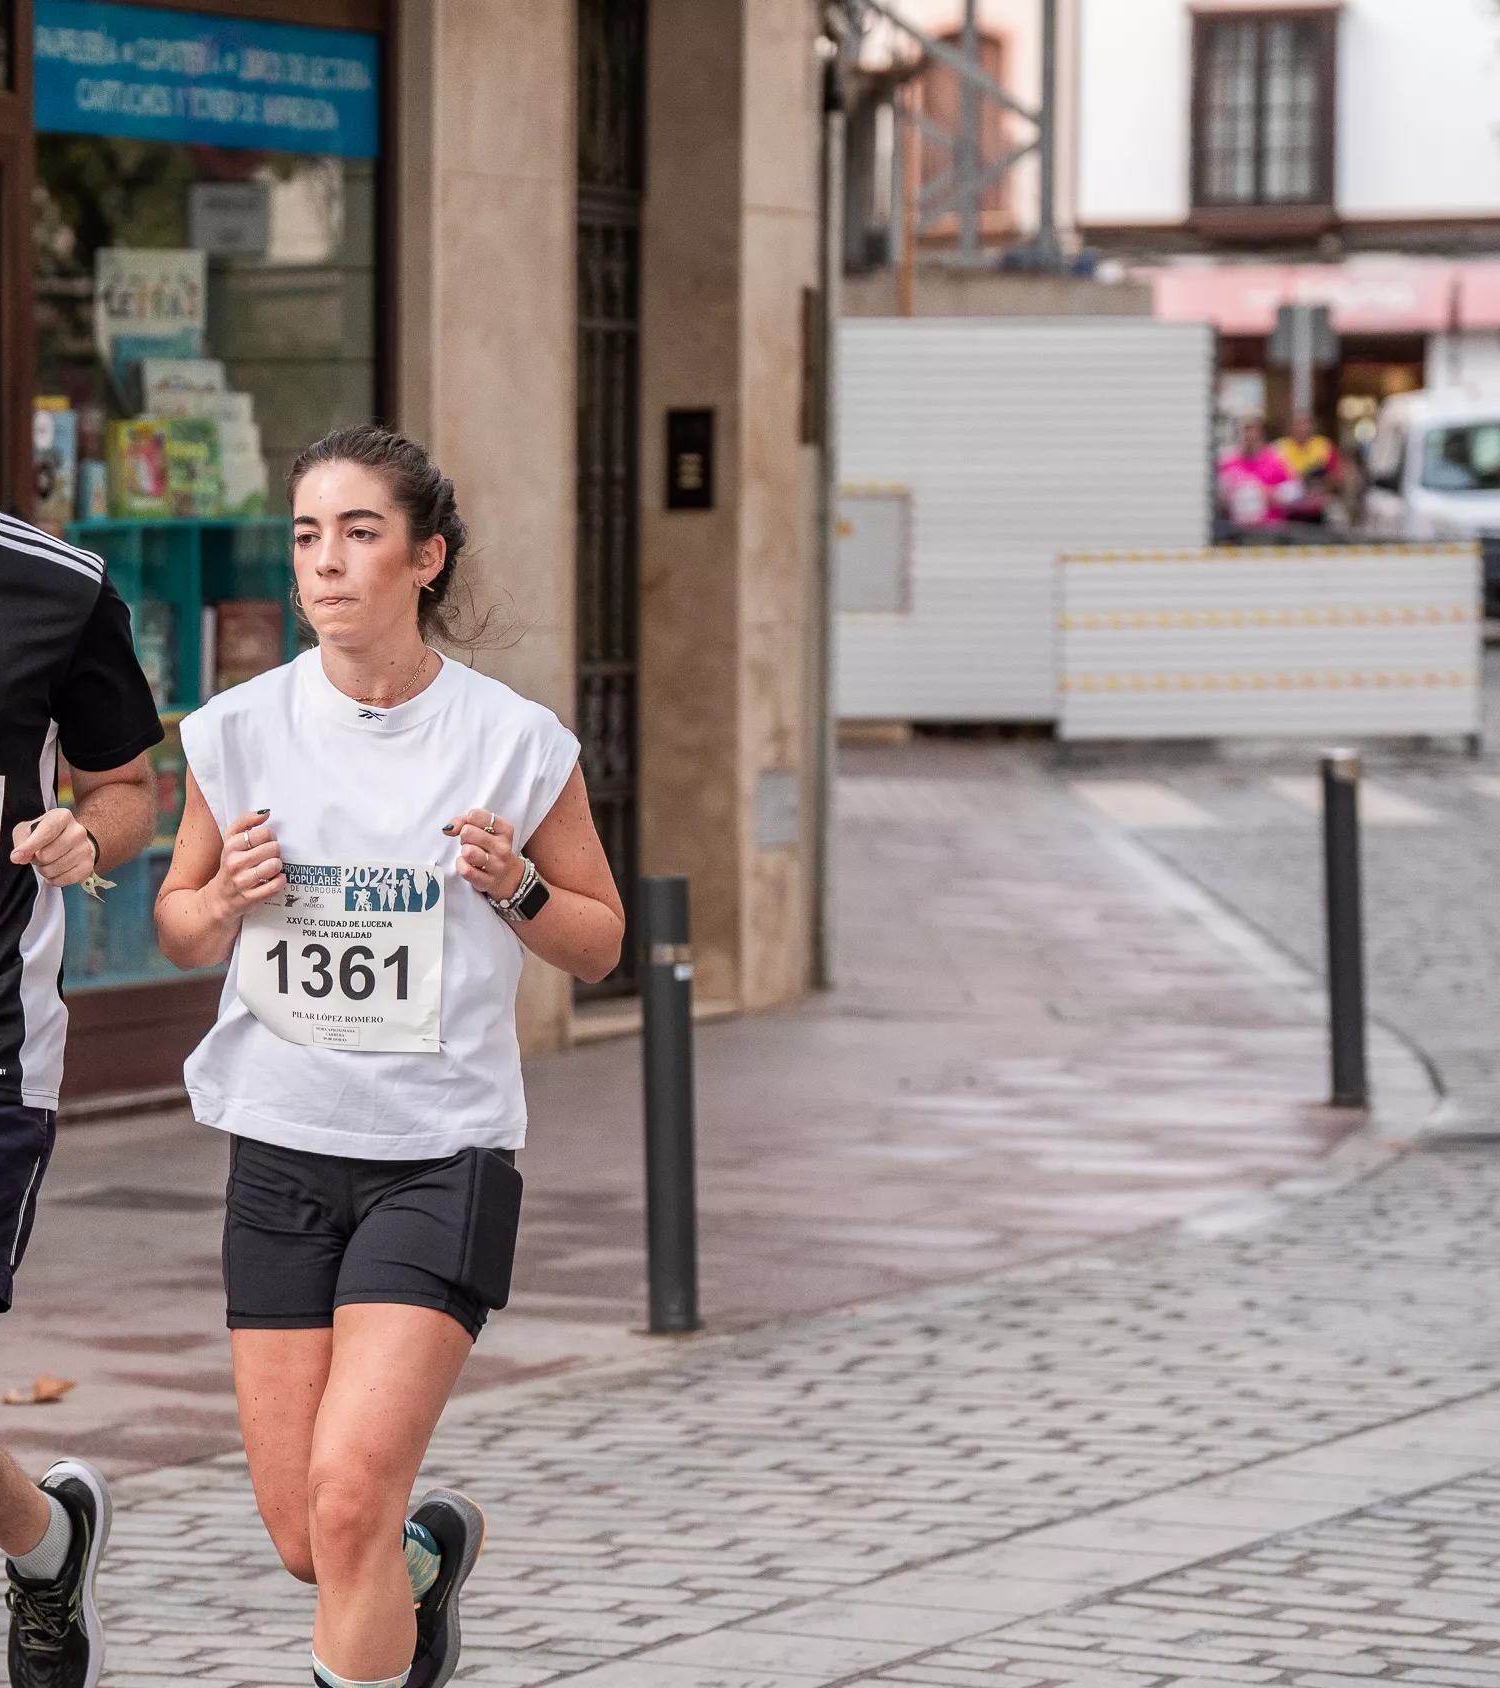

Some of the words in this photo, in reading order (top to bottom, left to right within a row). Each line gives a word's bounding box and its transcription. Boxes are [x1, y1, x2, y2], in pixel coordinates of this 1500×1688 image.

[282, 863, 328, 877] PROVINCIAL
[330, 866, 341, 877] DE
[289, 874, 342, 886] POPULARES
[345, 866, 399, 887] 2024
[290, 884, 300, 892] DE
[304, 885, 342, 894] CÓRDOBA
[286, 916, 303, 925] XXV
[303, 918, 317, 926] C.P.
[318, 919, 348, 928] CIUDAD
[349, 920, 360, 928] DE
[361, 920, 393, 928] LUCENA
[302, 930, 317, 938] POR
[318, 930, 329, 938] LA
[330, 931, 372, 939] IGUALDAD
[266, 940, 409, 1001] 1361
[292, 1011, 316, 1021] PILAR
[316, 1012, 343, 1023] LÓPEZ
[344, 1015, 384, 1024] ROMERO
